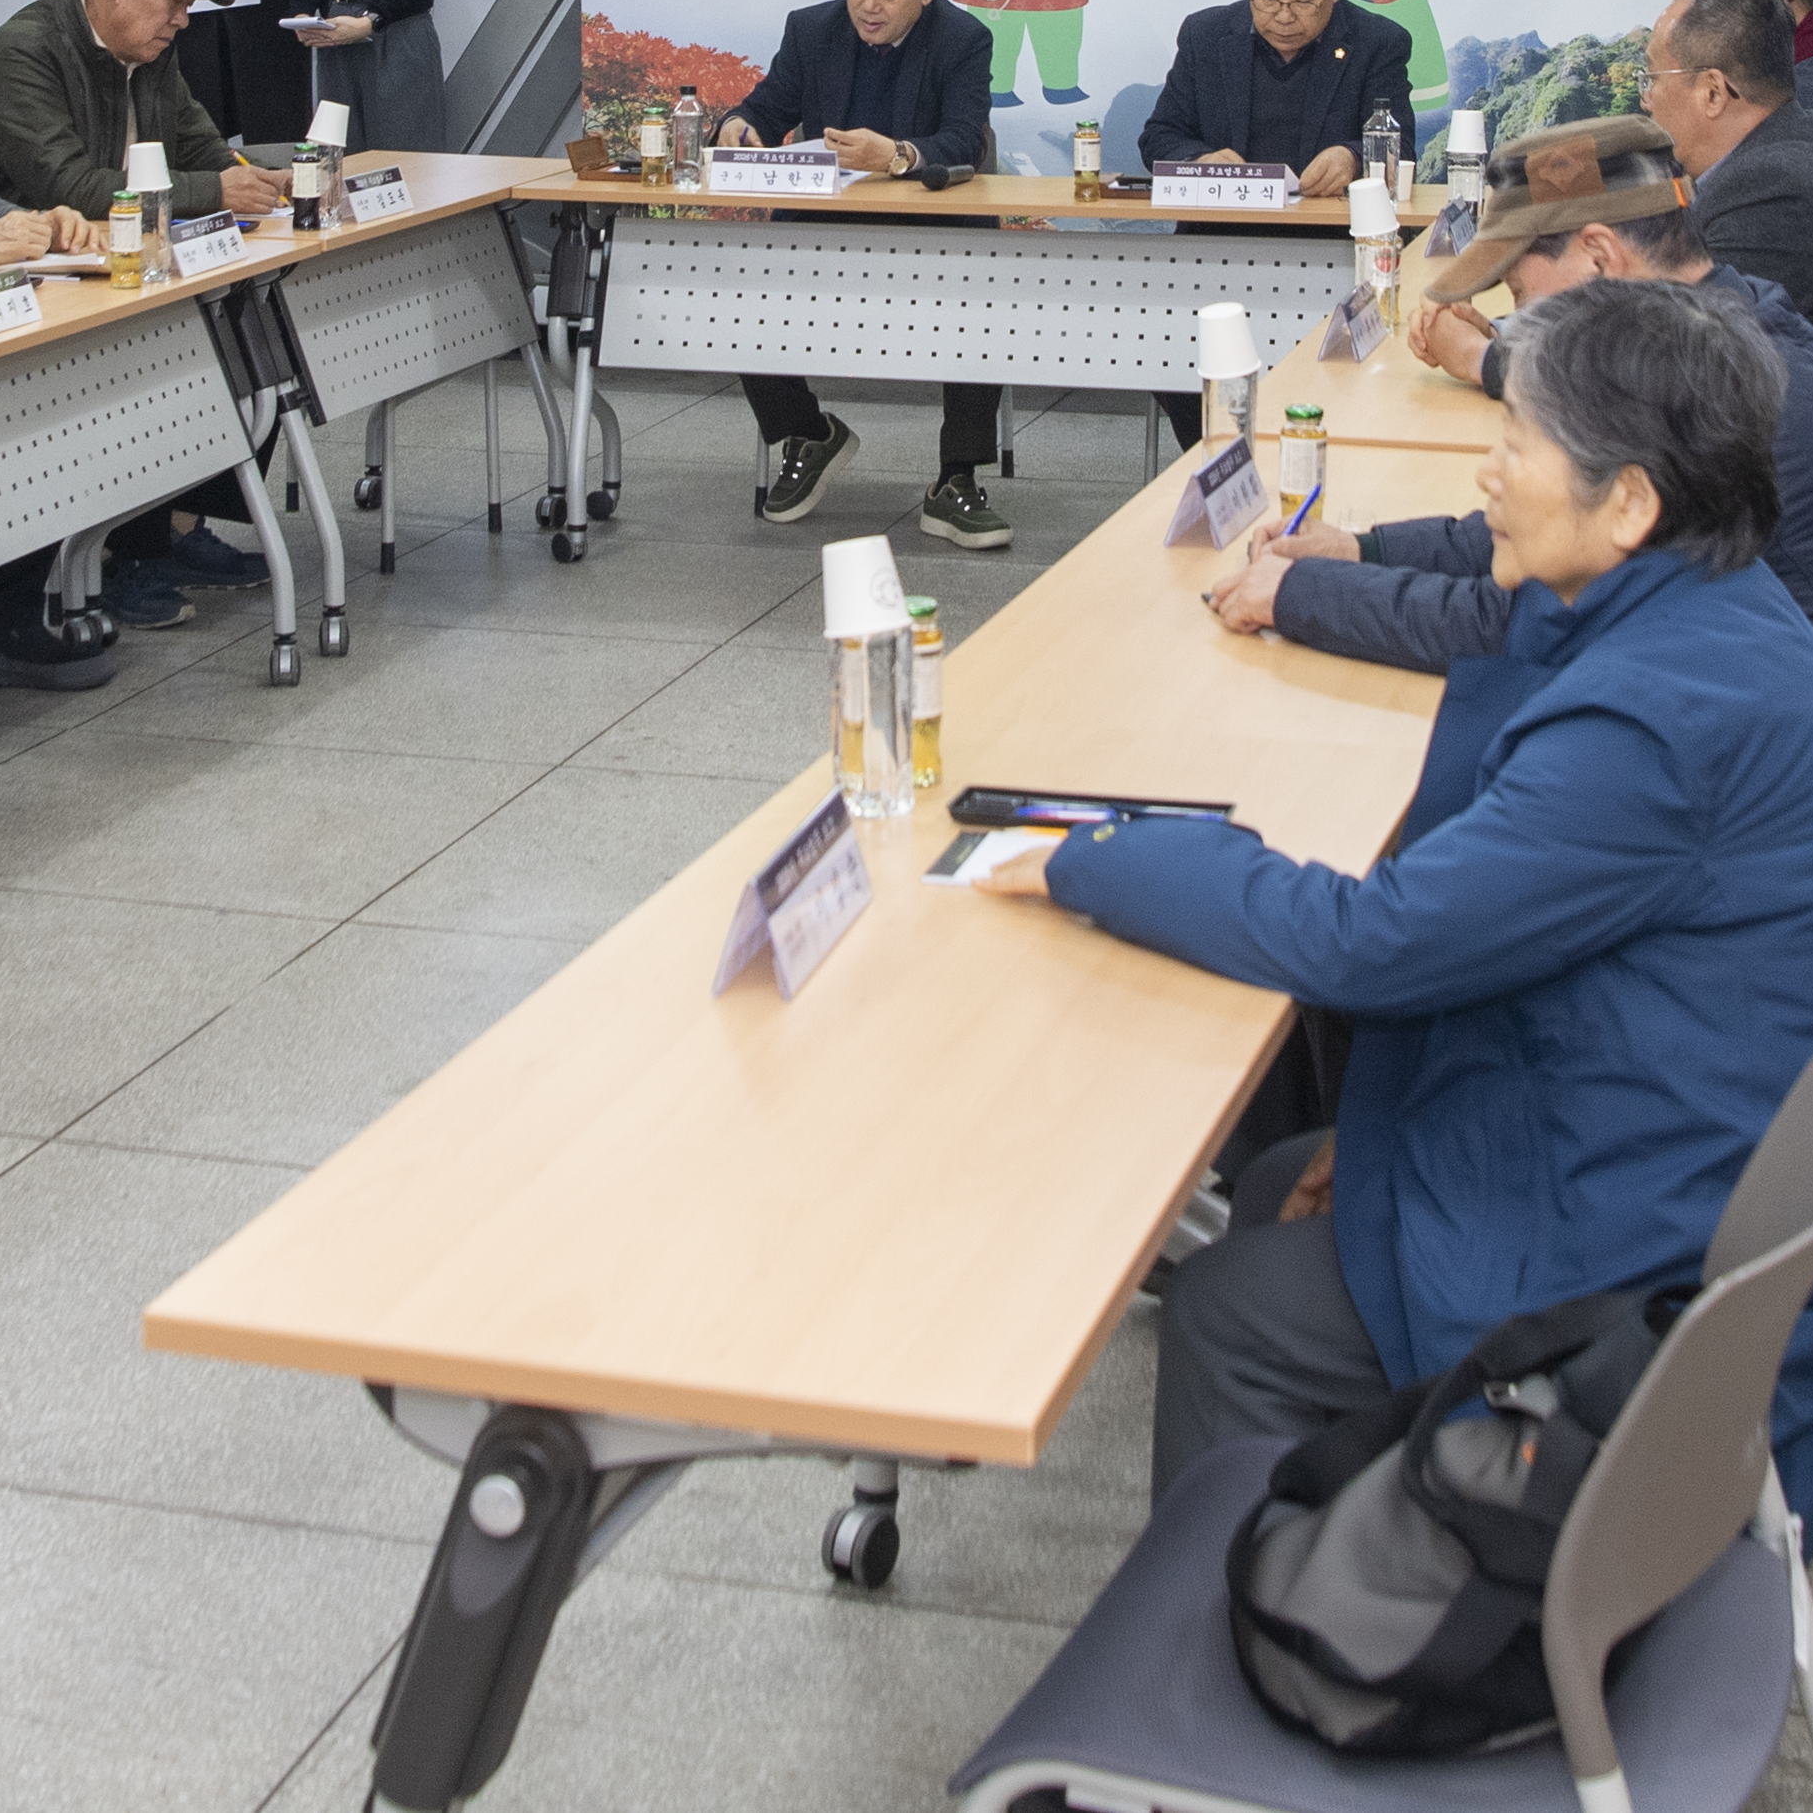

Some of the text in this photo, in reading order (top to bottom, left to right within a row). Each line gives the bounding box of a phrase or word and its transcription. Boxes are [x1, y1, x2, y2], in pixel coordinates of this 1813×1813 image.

[762, 154, 794, 163] 주요업무
[798, 155, 815, 163] 보고
[1207, 167, 1241, 176] 주요업무
[1245, 168, 1263, 177] 보고
